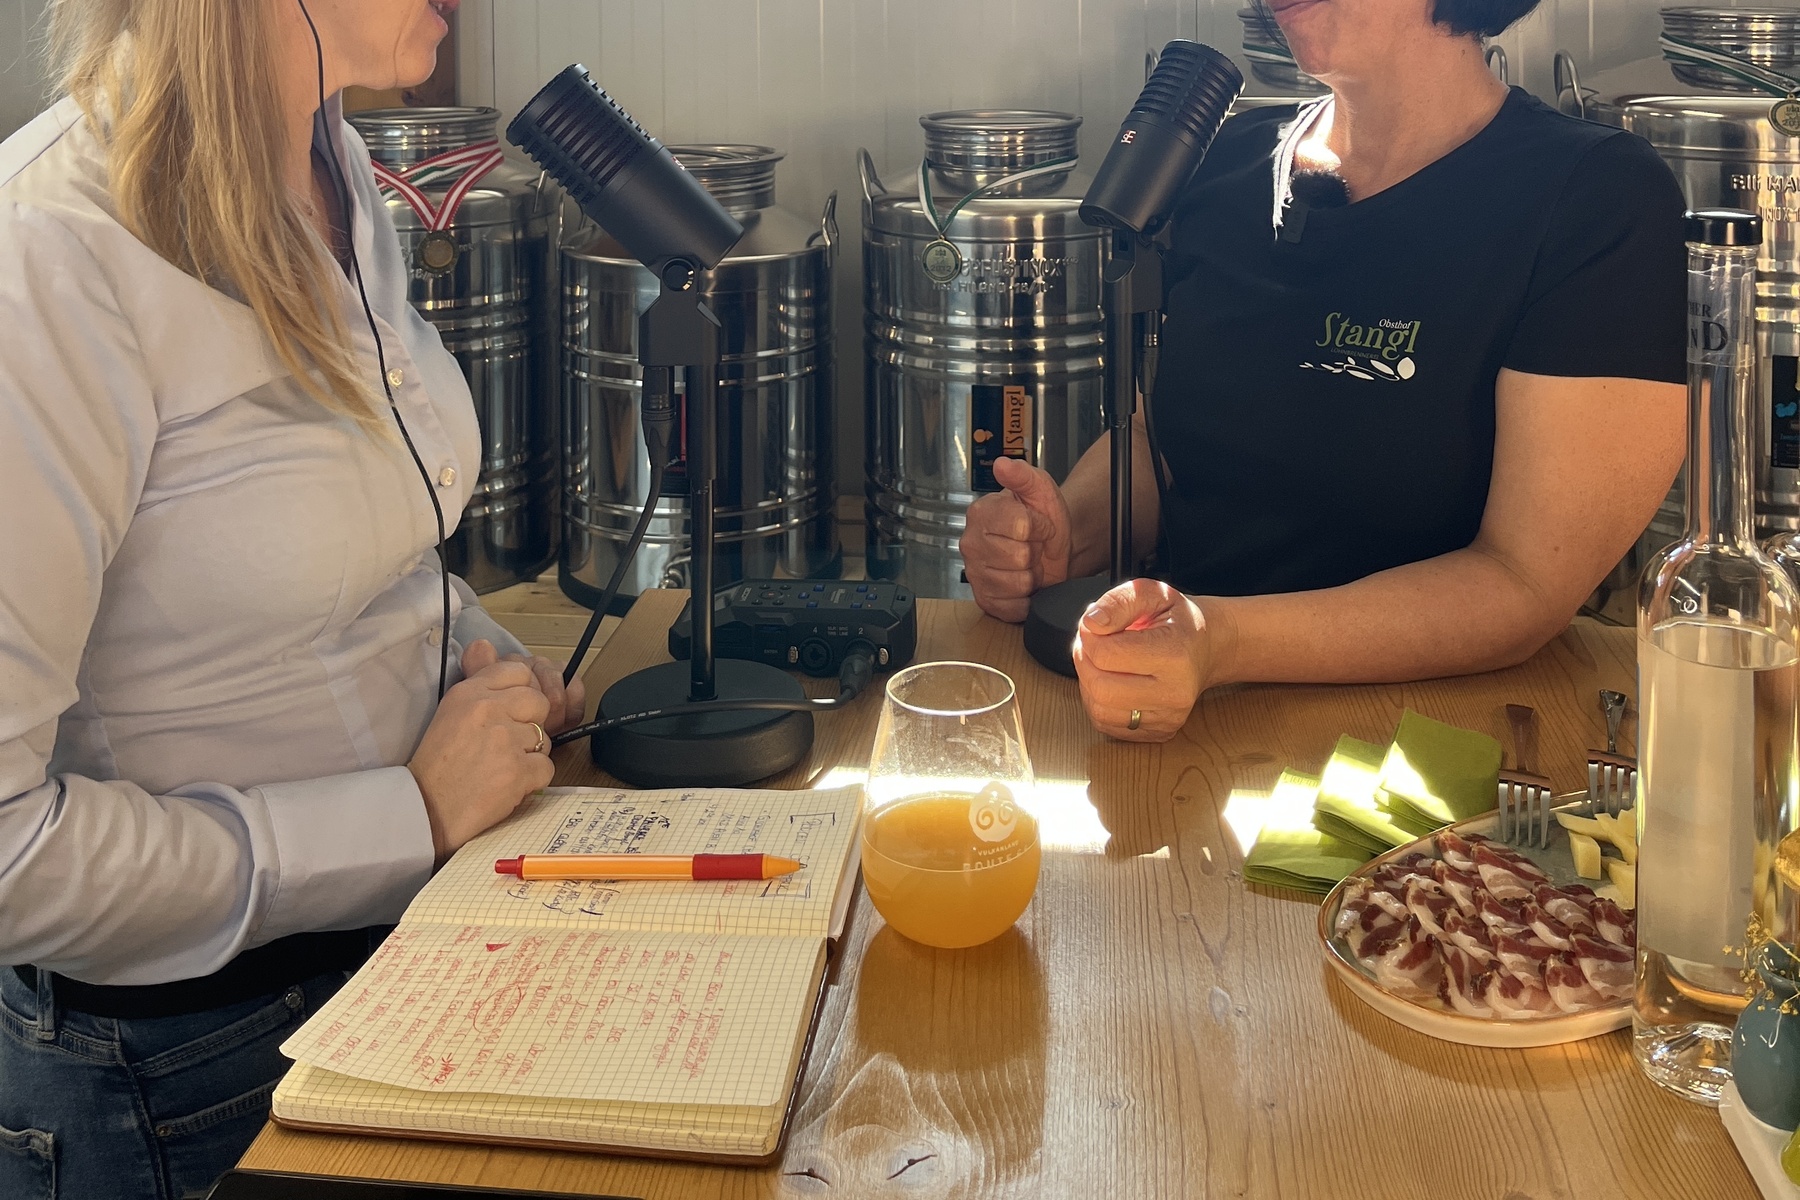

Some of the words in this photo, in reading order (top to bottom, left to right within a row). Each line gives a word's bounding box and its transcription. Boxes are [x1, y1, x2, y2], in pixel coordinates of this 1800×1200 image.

[1378, 318, 1414, 330] Obsthof
[1315, 311, 1421, 361] Stangl
[978, 840, 1019, 856] VULKANLAND
